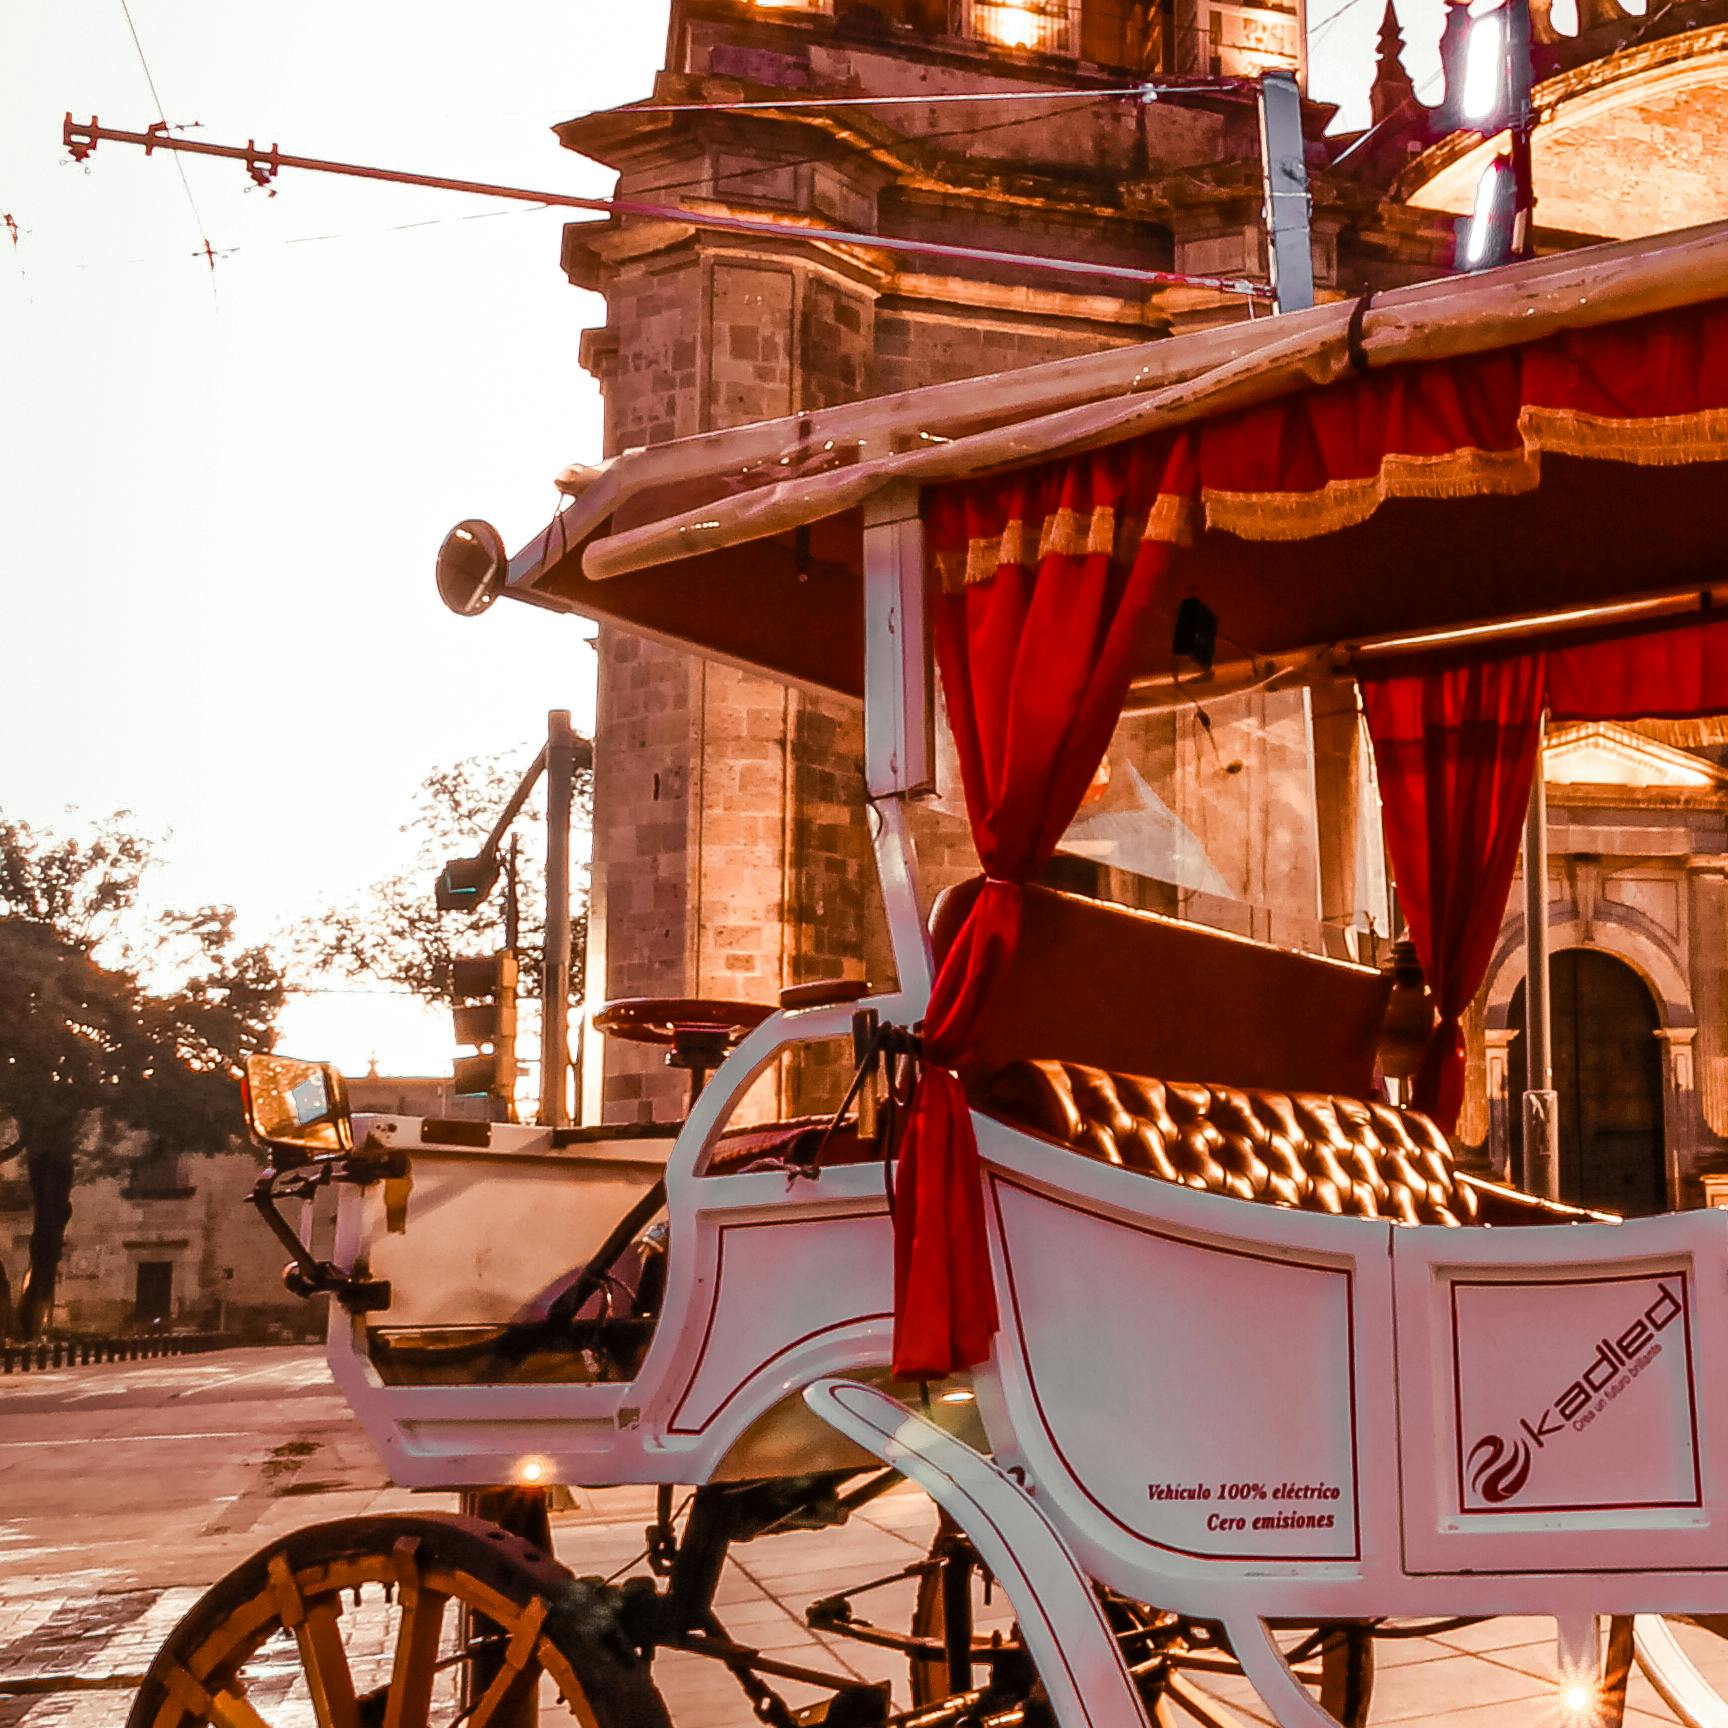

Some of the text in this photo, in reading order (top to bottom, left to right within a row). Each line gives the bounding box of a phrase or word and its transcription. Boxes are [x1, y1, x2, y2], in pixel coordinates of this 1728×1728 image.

[1520, 1283, 1682, 1448] kadled
[1573, 1410, 1595, 1432] Crea
[1594, 1399, 1607, 1412] un
[1147, 1481, 1340, 1501] Vehículo 100% eléctrico
[1207, 1511, 1335, 1531] Cero emisiones
